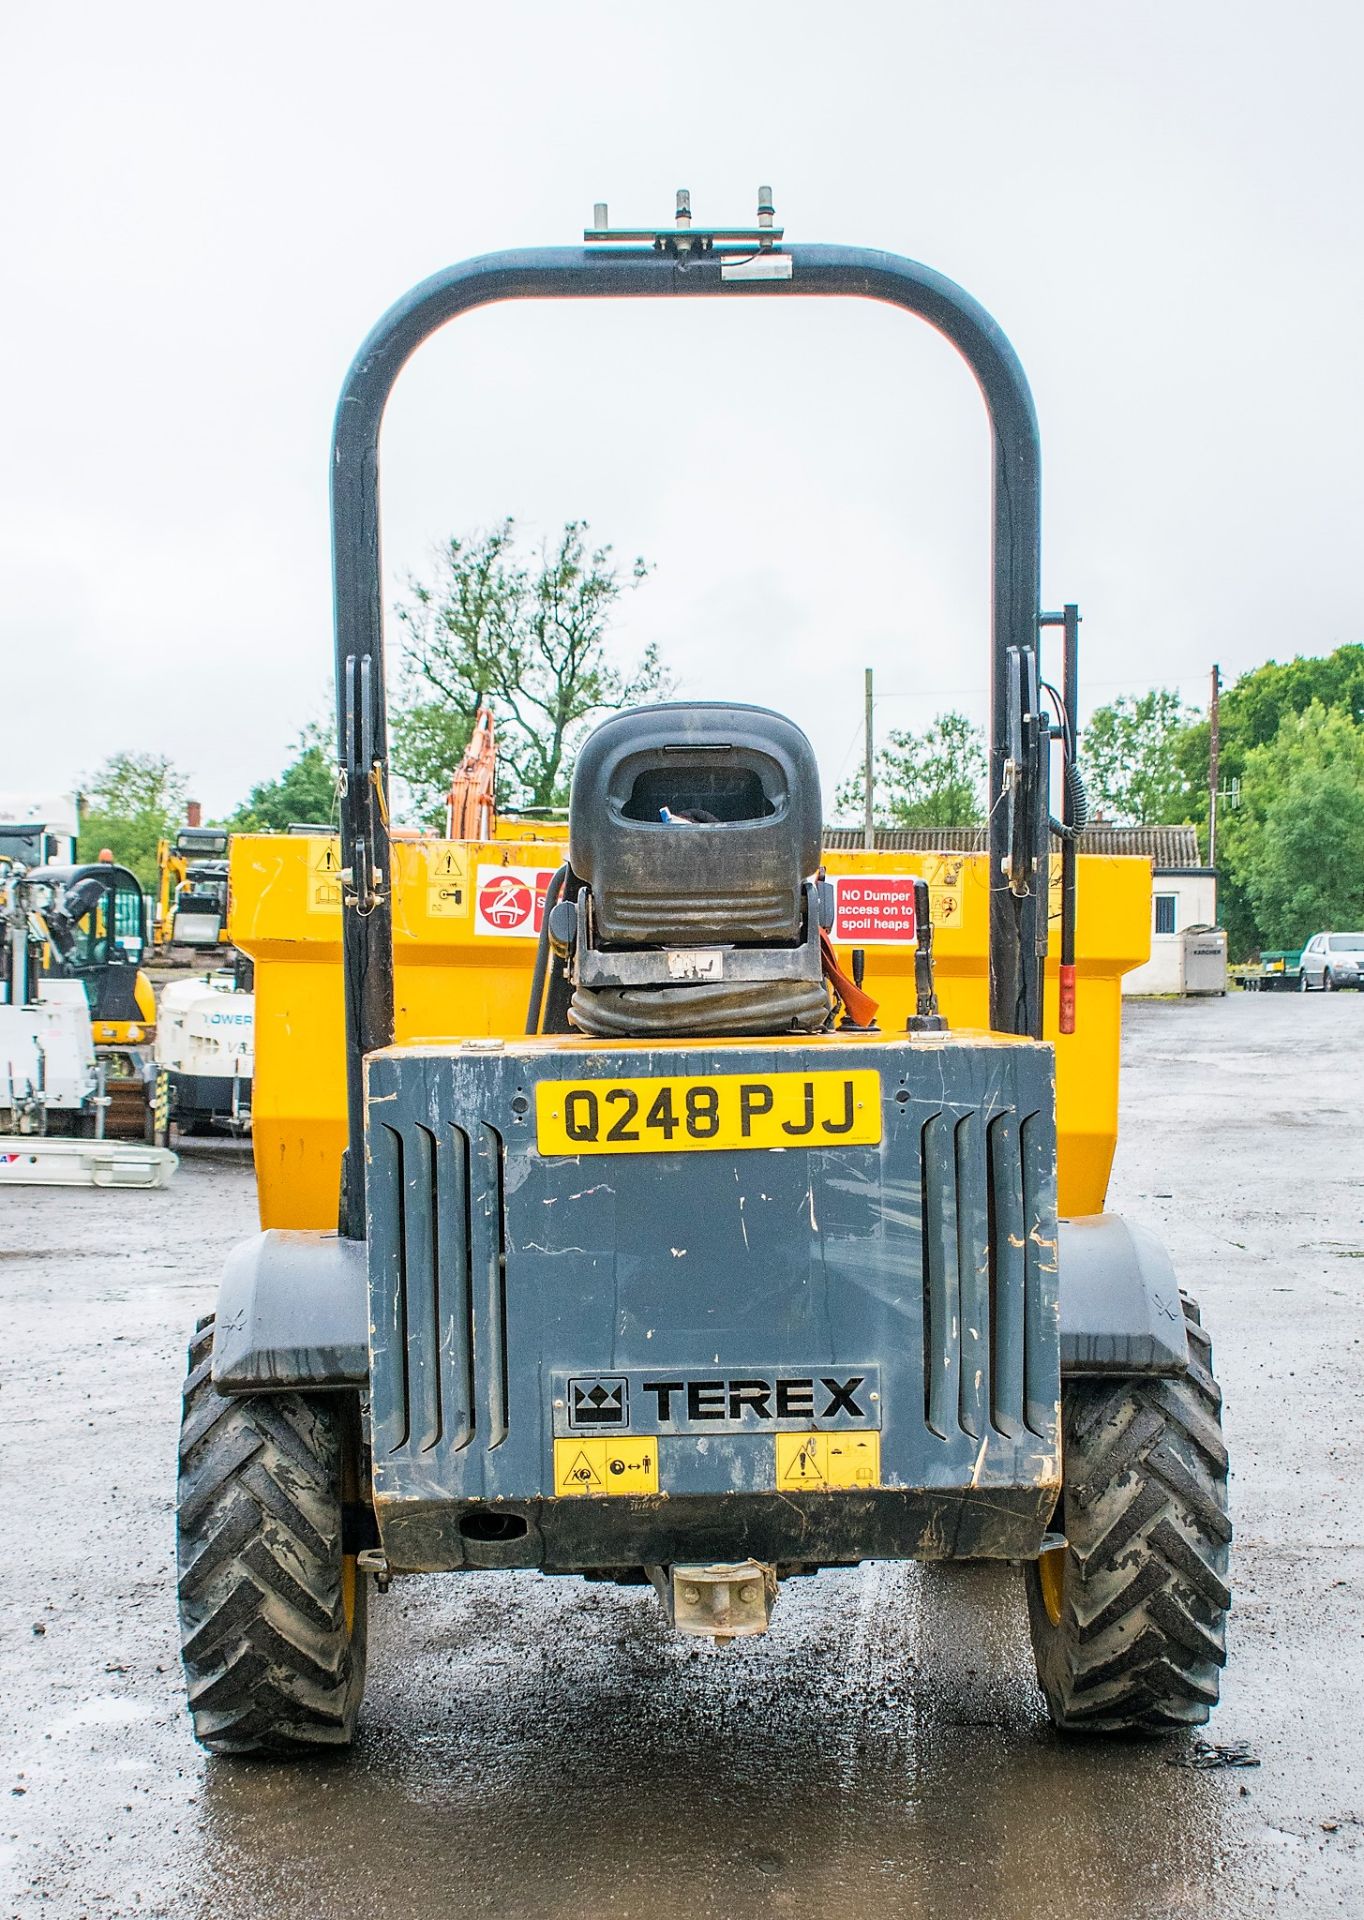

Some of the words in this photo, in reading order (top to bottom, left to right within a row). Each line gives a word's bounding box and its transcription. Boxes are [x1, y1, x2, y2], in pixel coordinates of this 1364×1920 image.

[841, 889, 861, 901] NO
[864, 889, 911, 904] Dumper
[838, 905, 880, 915] access
[882, 905, 898, 915] on
[901, 904, 914, 916] to
[841, 918, 871, 931] spoil
[874, 918, 911, 931] heaps
[564, 1086, 720, 1143] Q248
[740, 1080, 855, 1138] PJJ
[642, 1377, 866, 1421] TEREX
